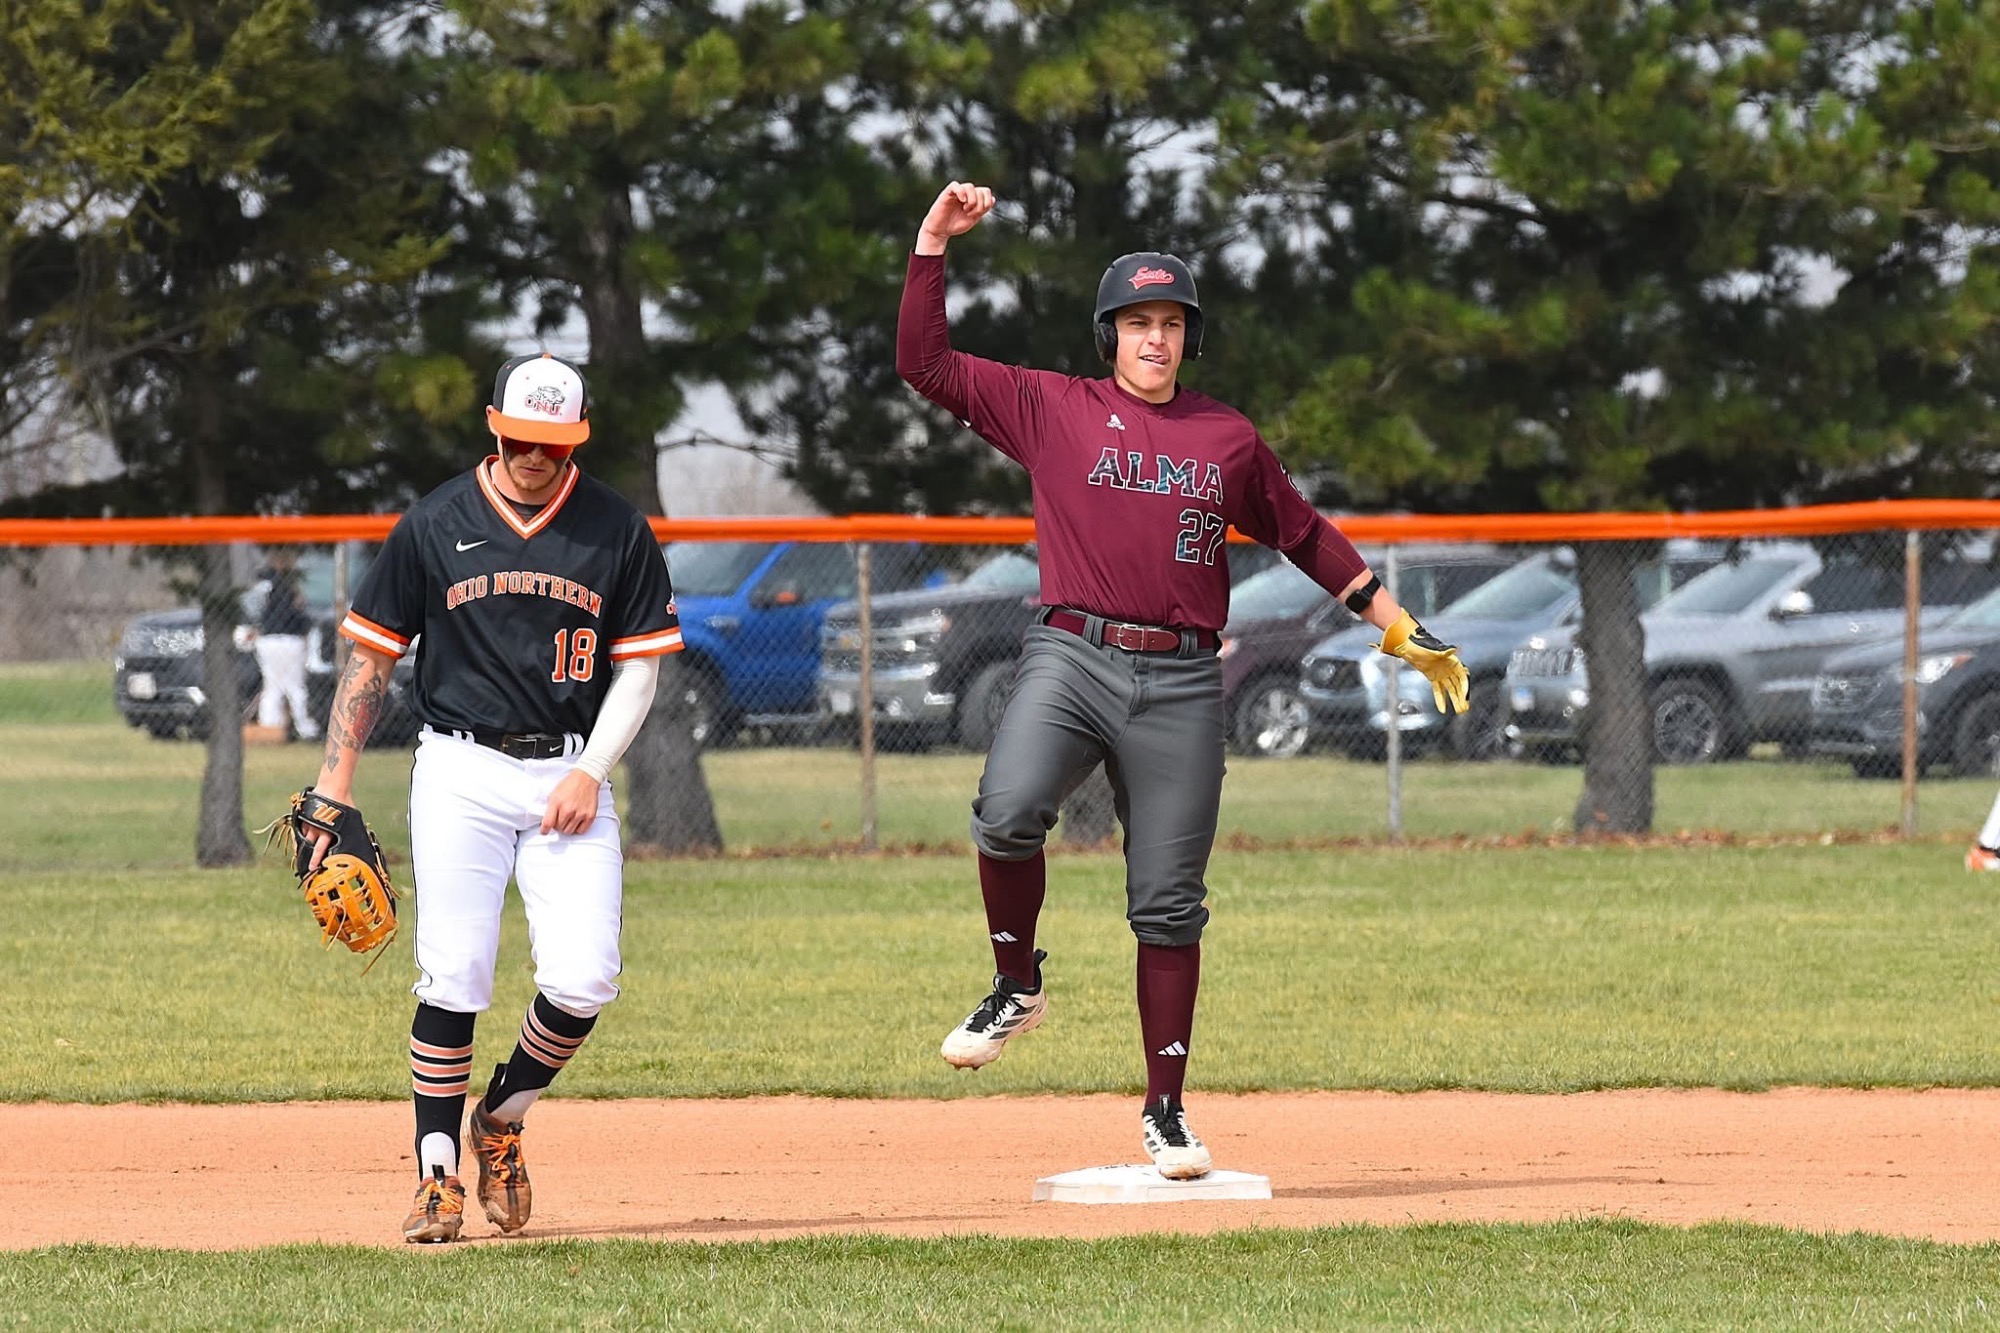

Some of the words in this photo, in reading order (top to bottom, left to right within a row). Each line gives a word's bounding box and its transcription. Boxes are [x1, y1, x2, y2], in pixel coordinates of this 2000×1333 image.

[1088, 447, 1224, 505] ALMA
[1175, 508, 1224, 566] 27
[446, 575, 488, 610] OHIO
[493, 571, 603, 618] NORTHERN
[552, 628, 597, 683] 18
